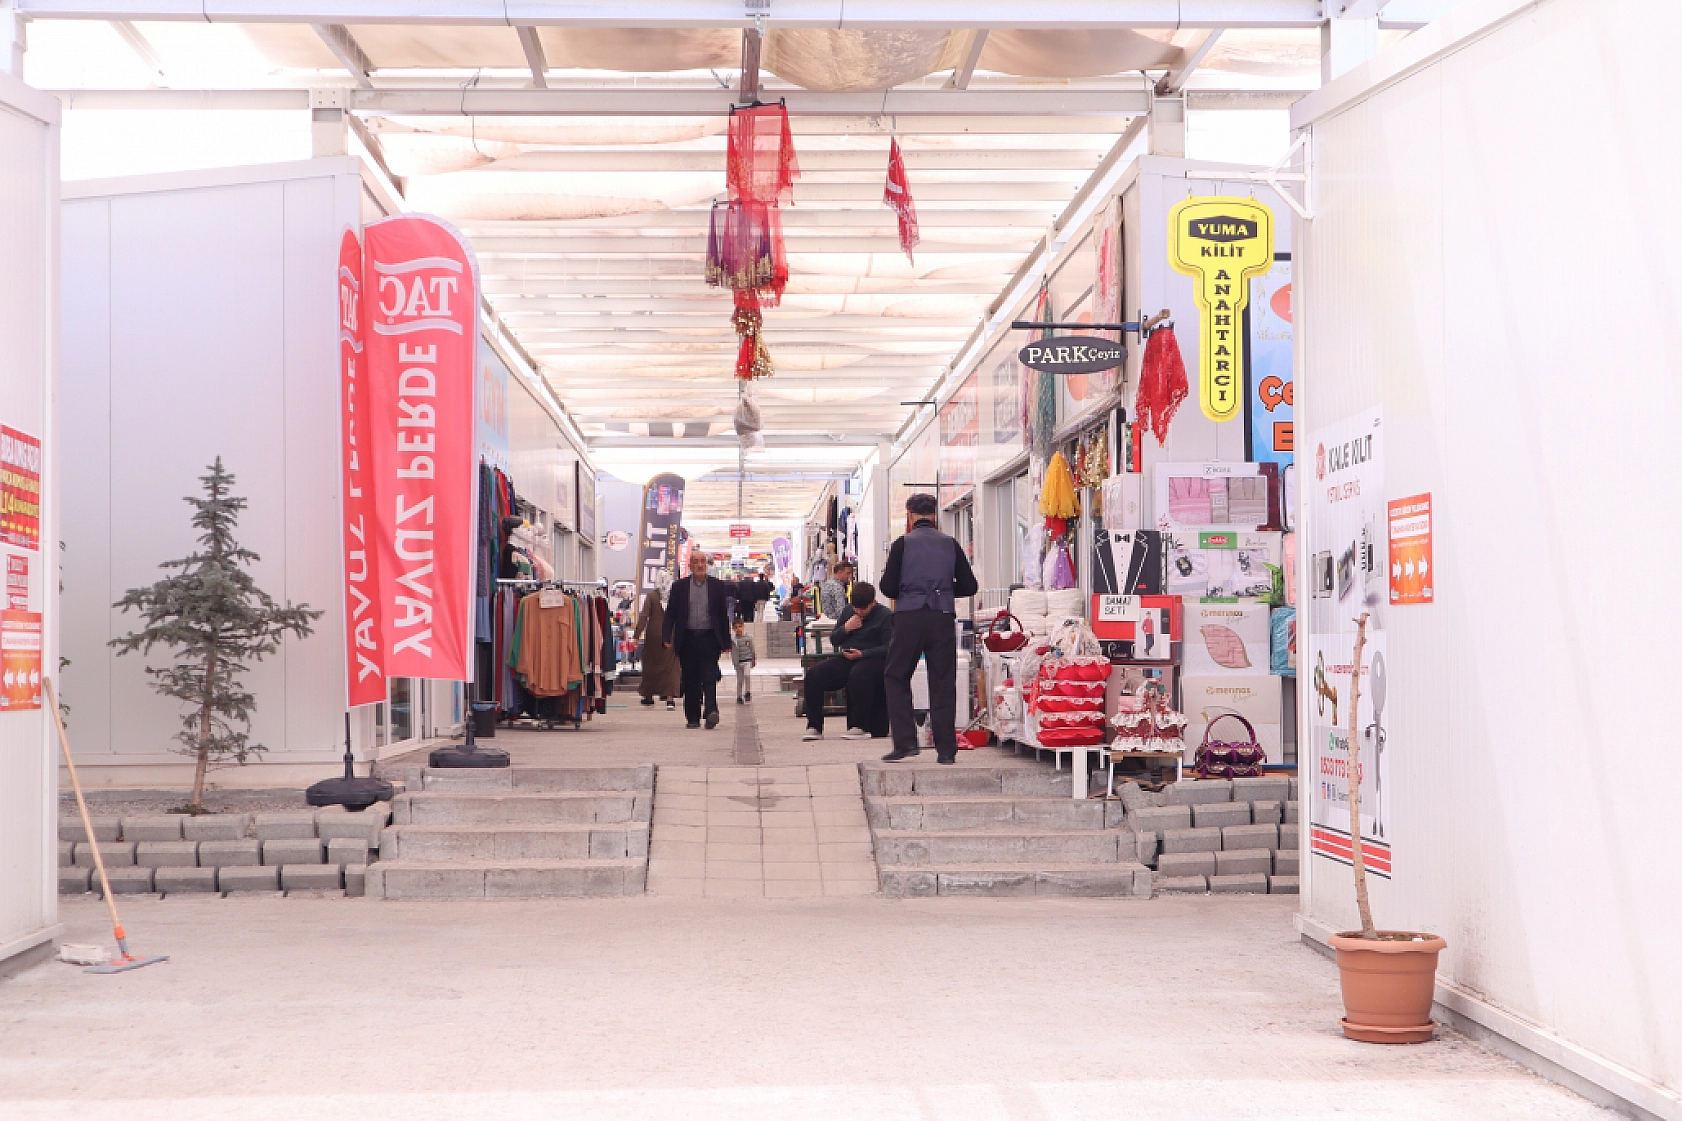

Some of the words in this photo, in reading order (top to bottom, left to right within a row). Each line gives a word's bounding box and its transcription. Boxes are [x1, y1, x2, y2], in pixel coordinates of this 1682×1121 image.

[1198, 223, 1249, 236] YUMA
[1201, 244, 1244, 257] KİLİT
[1214, 269, 1231, 401] ANAHTARCI
[1027, 346, 1089, 364] PARK
[1328, 442, 1349, 474] KALE
[350, 515, 381, 683] YAVUZ
